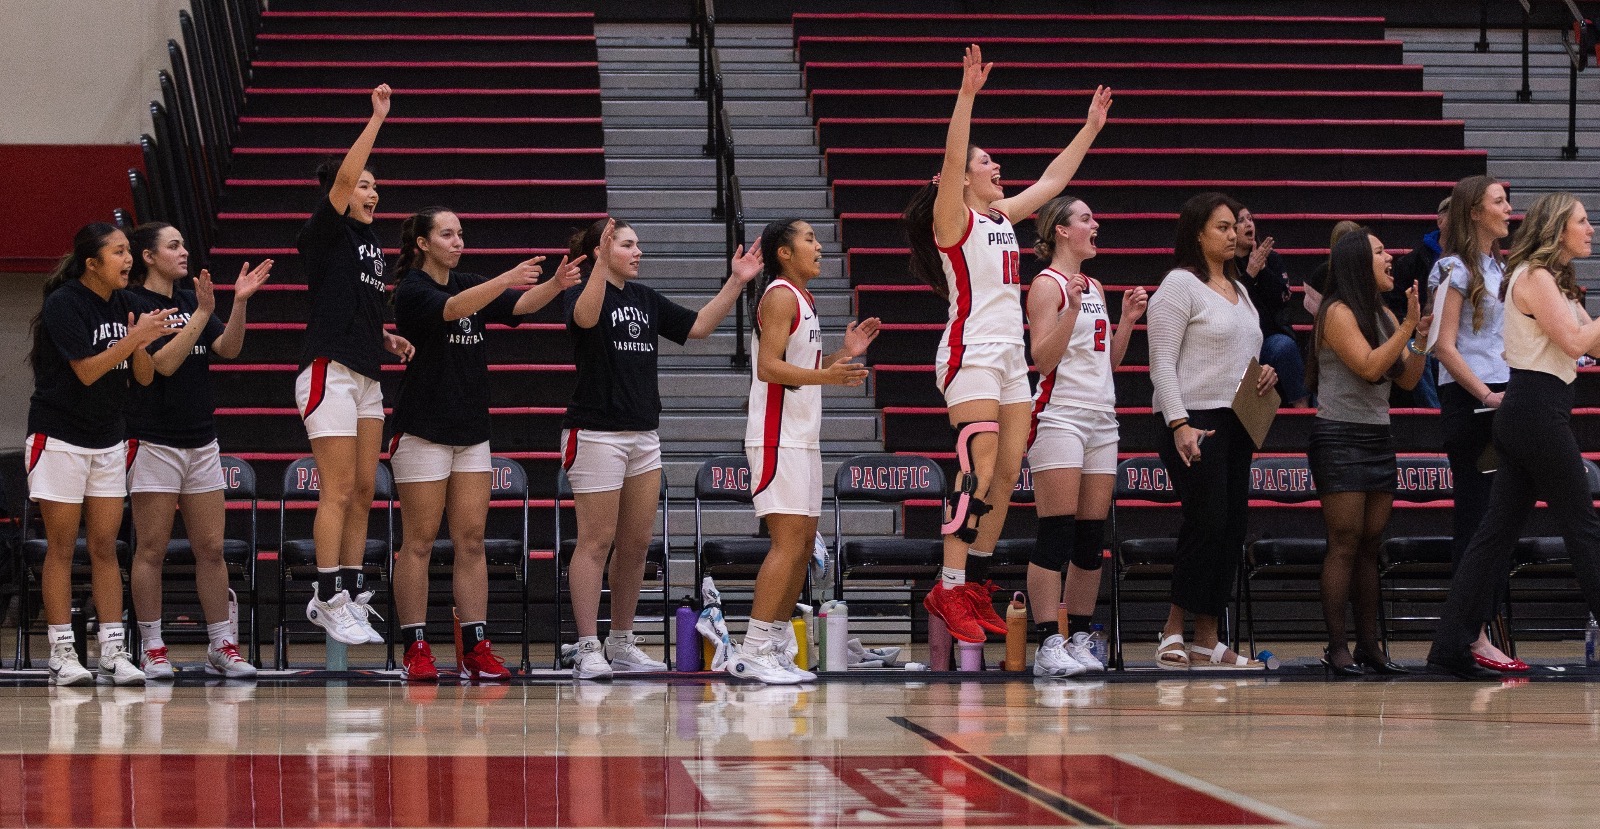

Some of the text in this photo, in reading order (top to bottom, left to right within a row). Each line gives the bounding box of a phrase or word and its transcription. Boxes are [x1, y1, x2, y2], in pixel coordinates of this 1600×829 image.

[988, 232, 1018, 245] PACIF
[1002, 250, 1020, 284] 10
[1081, 302, 1106, 314] ACIF
[447, 332, 484, 344] ASKETB
[1094, 319, 1107, 352] 2
[850, 466, 930, 490] PACIFIC
[1127, 467, 1173, 491] PACI
[1251, 467, 1317, 491] PACIF
[1396, 467, 1454, 490] ACIFIC
